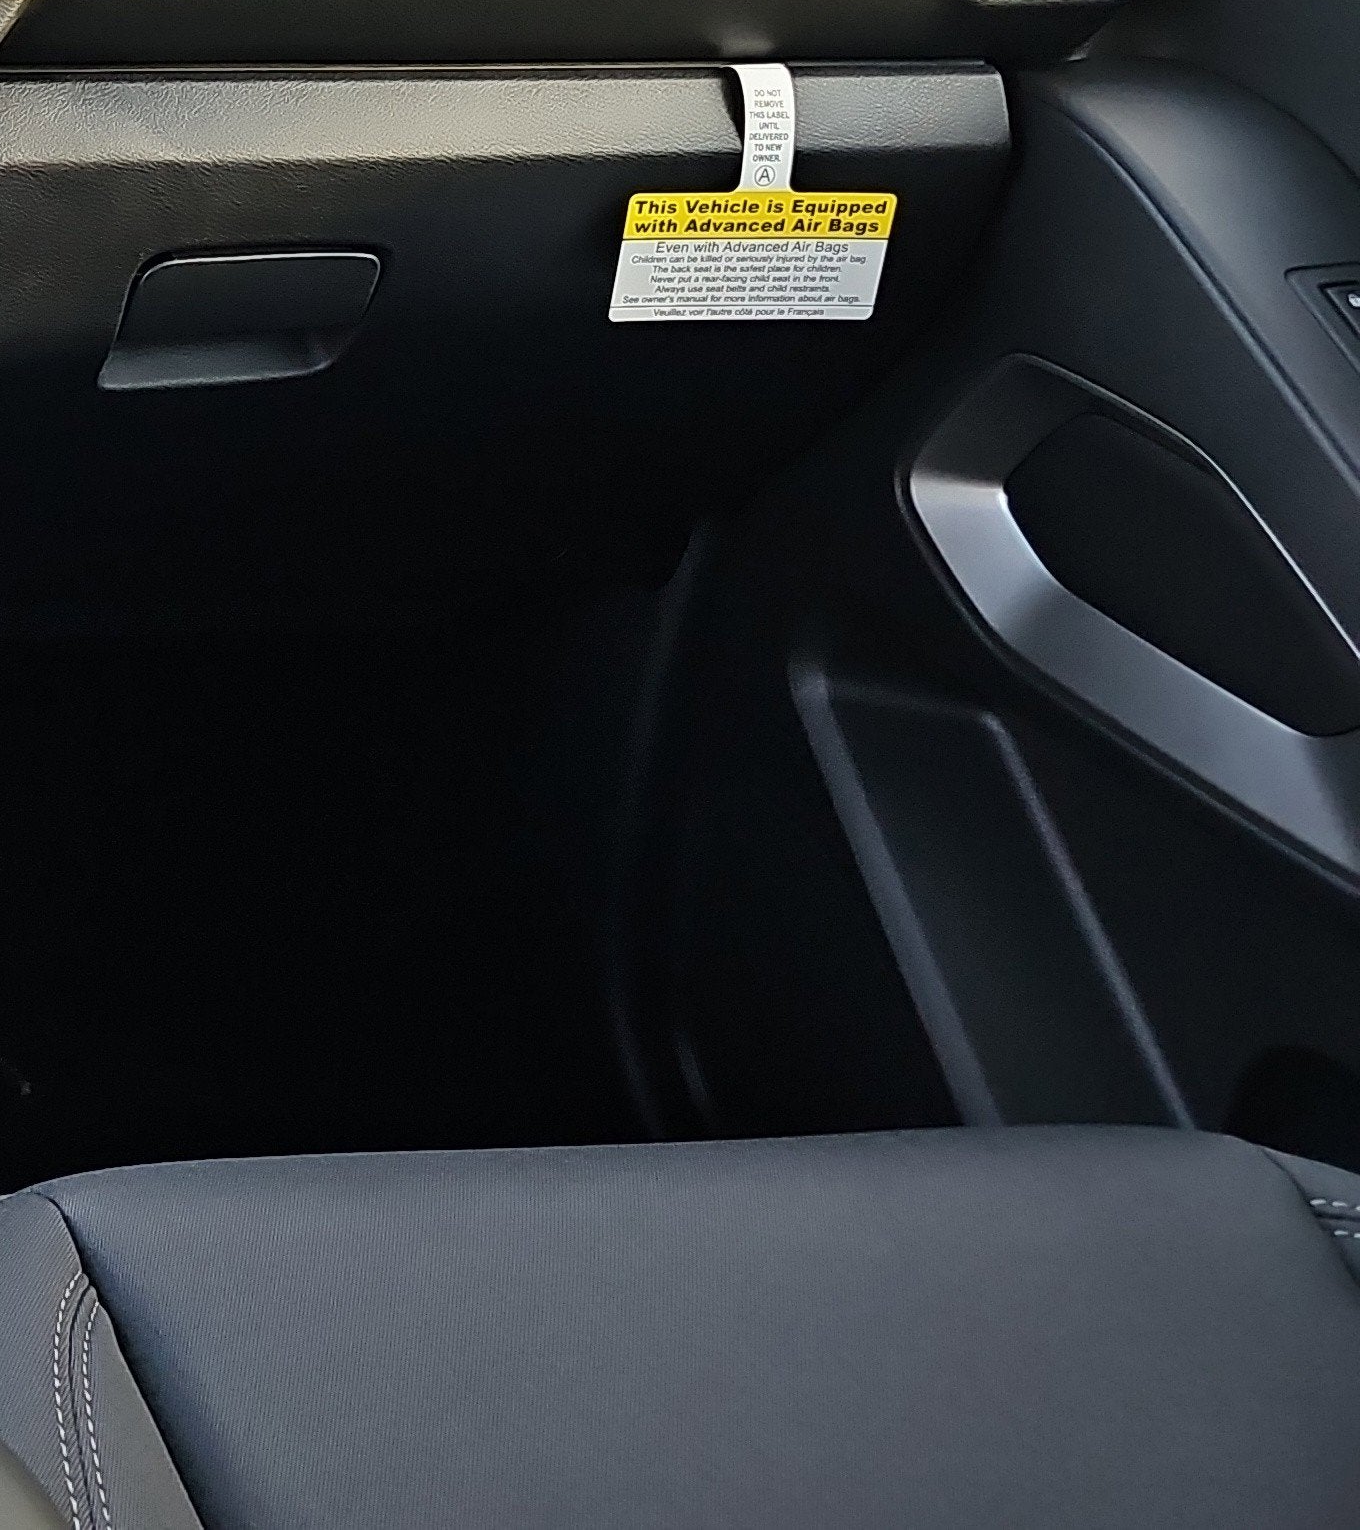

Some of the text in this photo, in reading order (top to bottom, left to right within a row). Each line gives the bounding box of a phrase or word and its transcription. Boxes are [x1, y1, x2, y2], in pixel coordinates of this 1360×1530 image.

[749, 111, 790, 119] THIS LABEL
[749, 133, 789, 141] DELIVERED
[754, 143, 783, 151] TO NEW
[758, 168, 771, 182] A
[635, 199, 888, 217] This Vehicle is Equipped
[635, 218, 880, 236] with Advanced Air Bags
[655, 241, 849, 255] Even with Advanced Air Bags
[631, 255, 667, 264] Children
[687, 255, 698, 263] be
[700, 255, 722, 263] killed
[735, 255, 773, 265] seriously
[775, 255, 805, 264] injured
[807, 255, 818, 264] by
[820, 255, 834, 263] the
[836, 255, 848, 263] air
[653, 265, 669, 273] The
[671, 265, 691, 273] back
[694, 265, 712, 273] seat
[714, 265, 721, 273] is
[723, 265, 737, 273] the
[739, 265, 766, 273] safest
[767, 265, 791, 274] place
[793, 265, 805, 273] for
